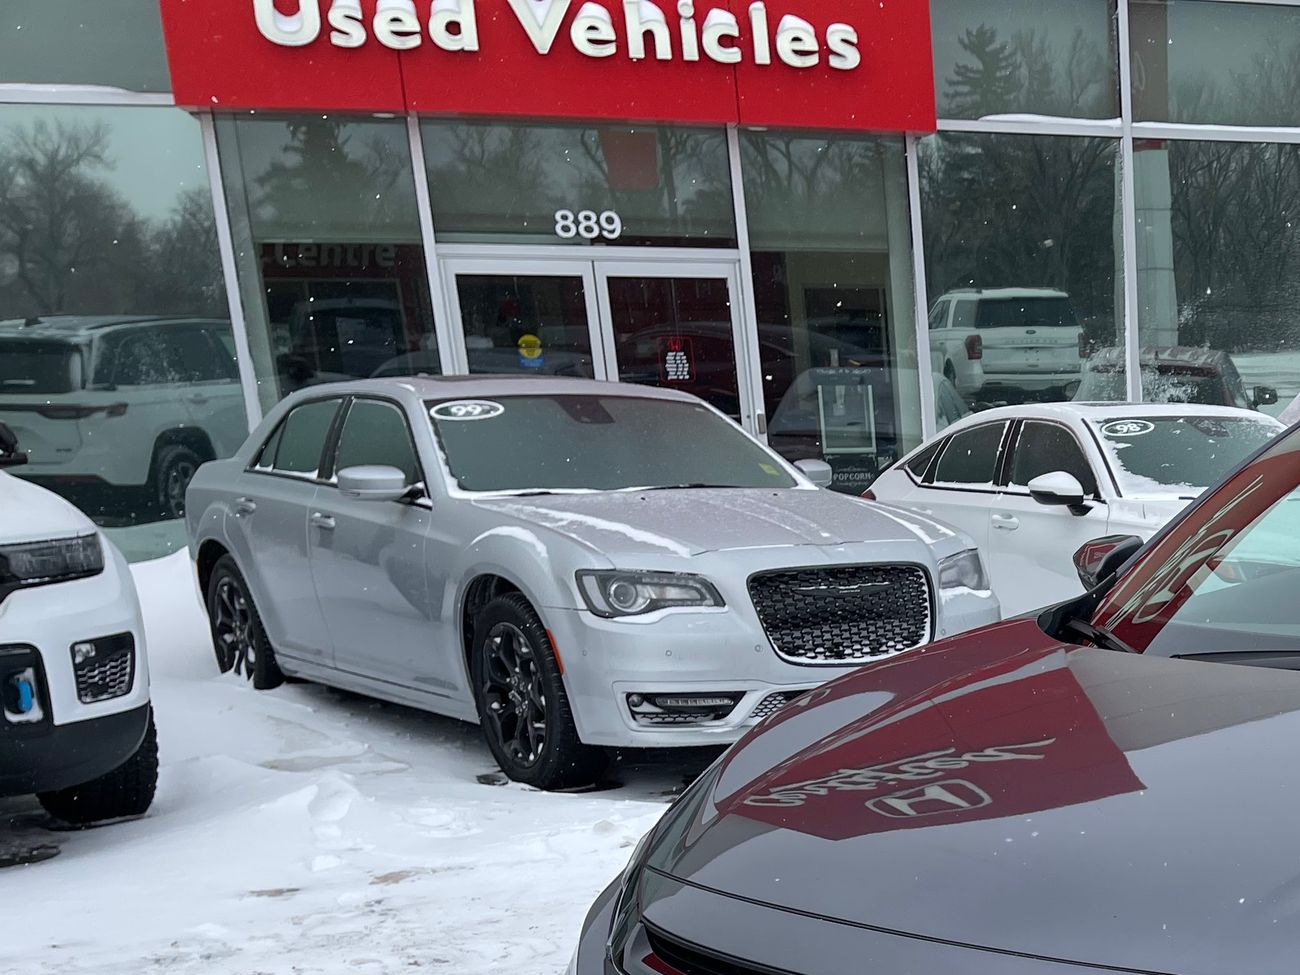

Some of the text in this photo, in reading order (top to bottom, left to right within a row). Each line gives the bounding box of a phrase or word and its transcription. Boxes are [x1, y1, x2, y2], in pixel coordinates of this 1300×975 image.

[254, 0, 862, 70] Used Vehicles
[554, 209, 622, 239] 889
